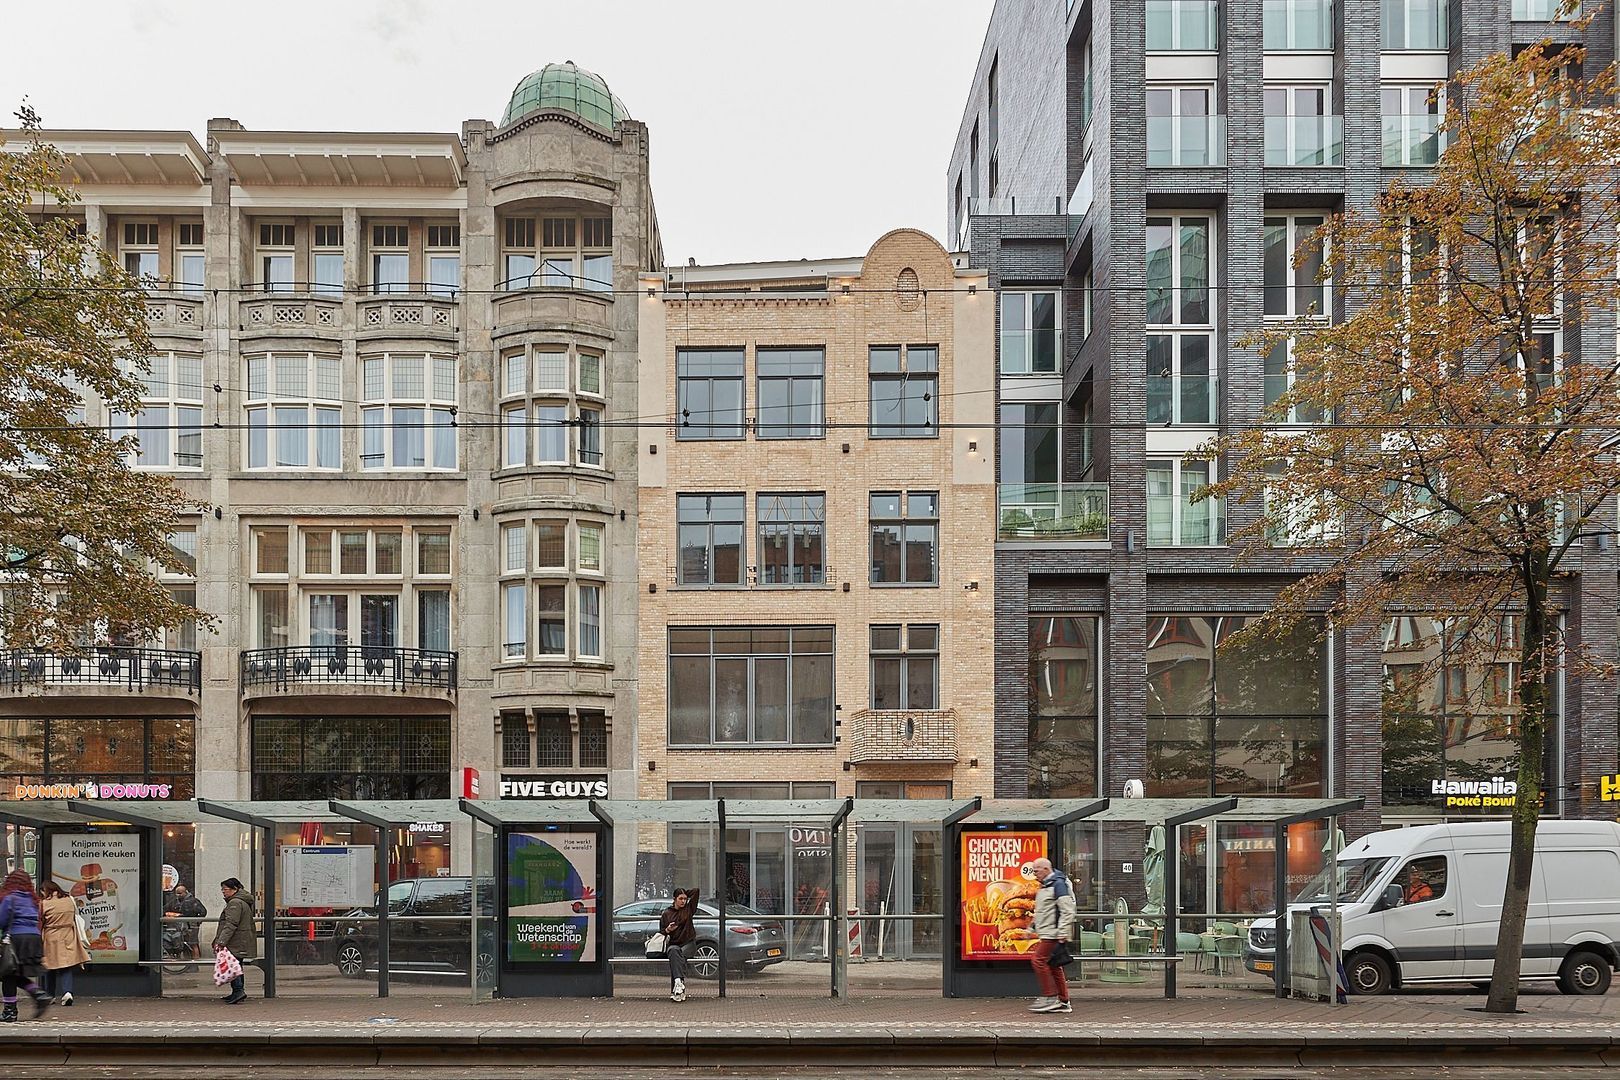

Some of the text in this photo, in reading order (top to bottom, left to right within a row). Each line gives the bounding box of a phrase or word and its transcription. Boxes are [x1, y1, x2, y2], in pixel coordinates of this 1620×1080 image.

[15, 784, 170, 799] DUNKIN' DONUTS
[499, 781, 545, 797] FIVE
[550, 780, 608, 798] GUYS
[1431, 776, 1517, 795] Hawaiia
[1446, 795, 1481, 807] Poké
[409, 823, 444, 832] SHAKES
[71, 840, 106, 849] Knijpmix
[968, 838, 1022, 853] CHICKEN
[57, 850, 136, 858] de Kleine Keuken
[969, 853, 1020, 867] BIG MAC
[968, 867, 1004, 882] MENU
[79, 903, 116, 916] Knijpmix
[516, 923, 565, 933] Weekend
[517, 932, 582, 943] Wetenschap
